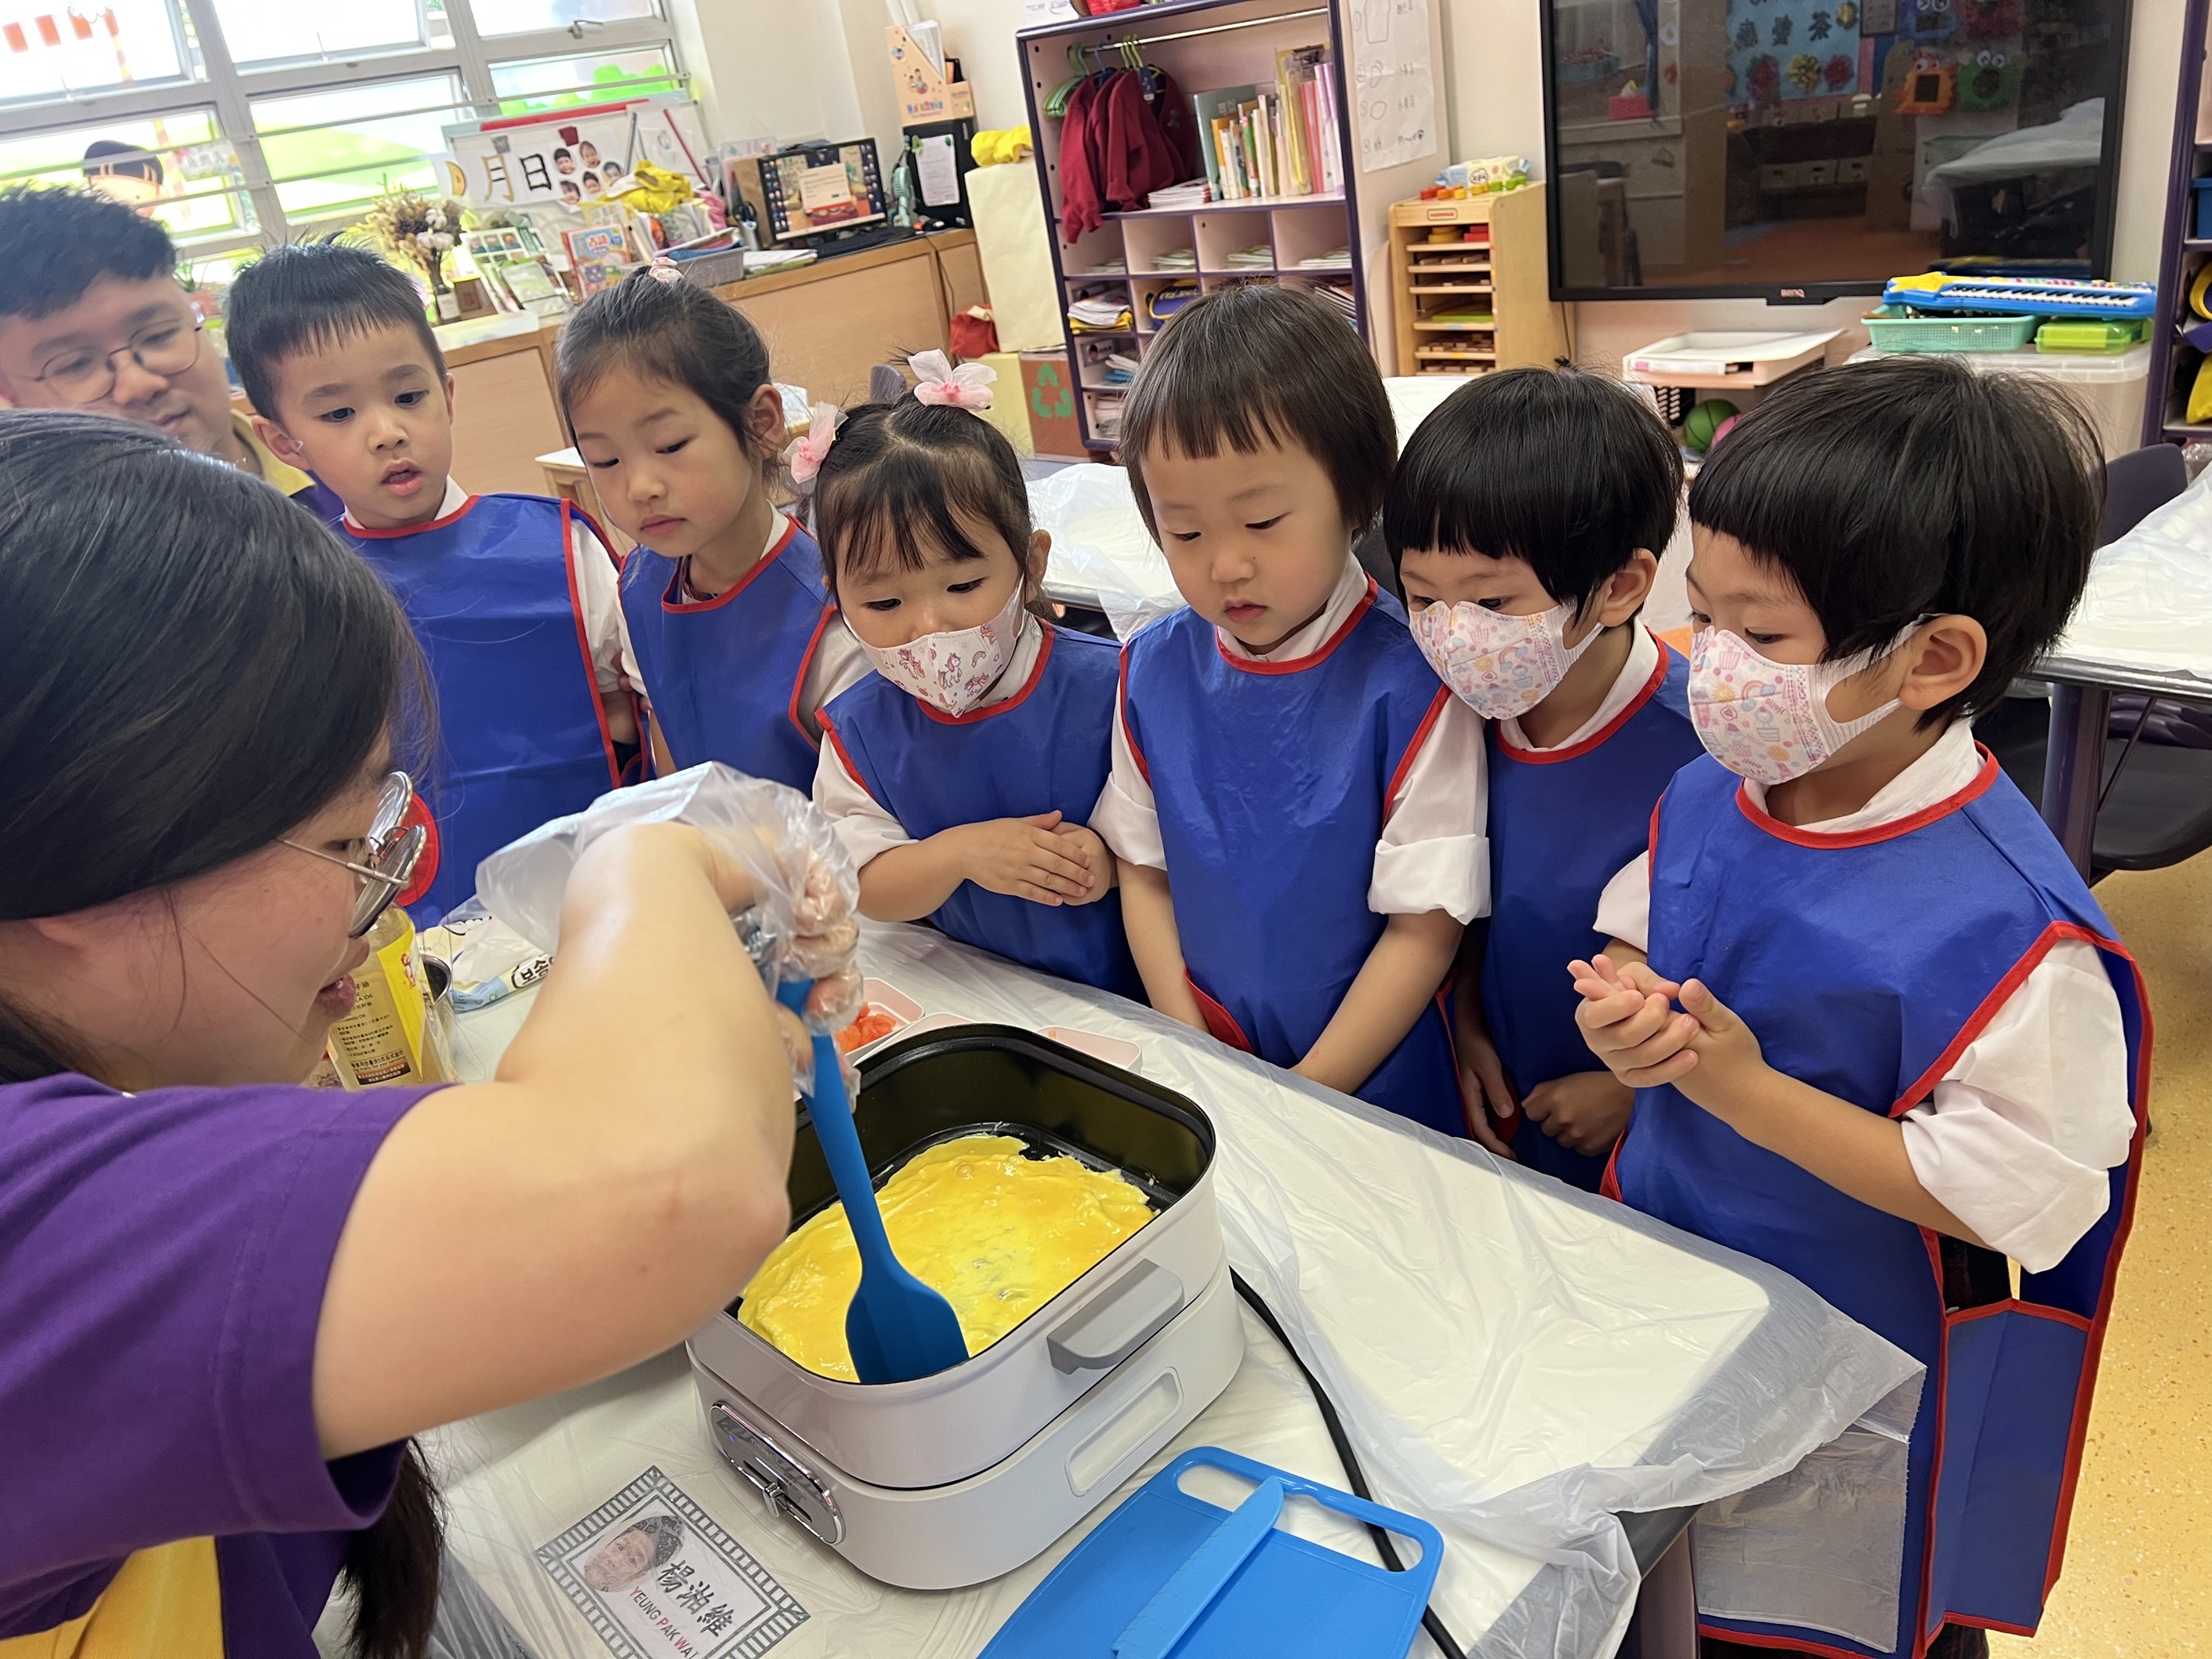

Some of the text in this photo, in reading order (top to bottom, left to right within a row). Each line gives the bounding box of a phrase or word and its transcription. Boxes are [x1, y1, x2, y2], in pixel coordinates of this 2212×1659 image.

[1765, 699, 1785, 715] Hello
[629, 1586, 699, 1659] YEUNG PAK WAI
